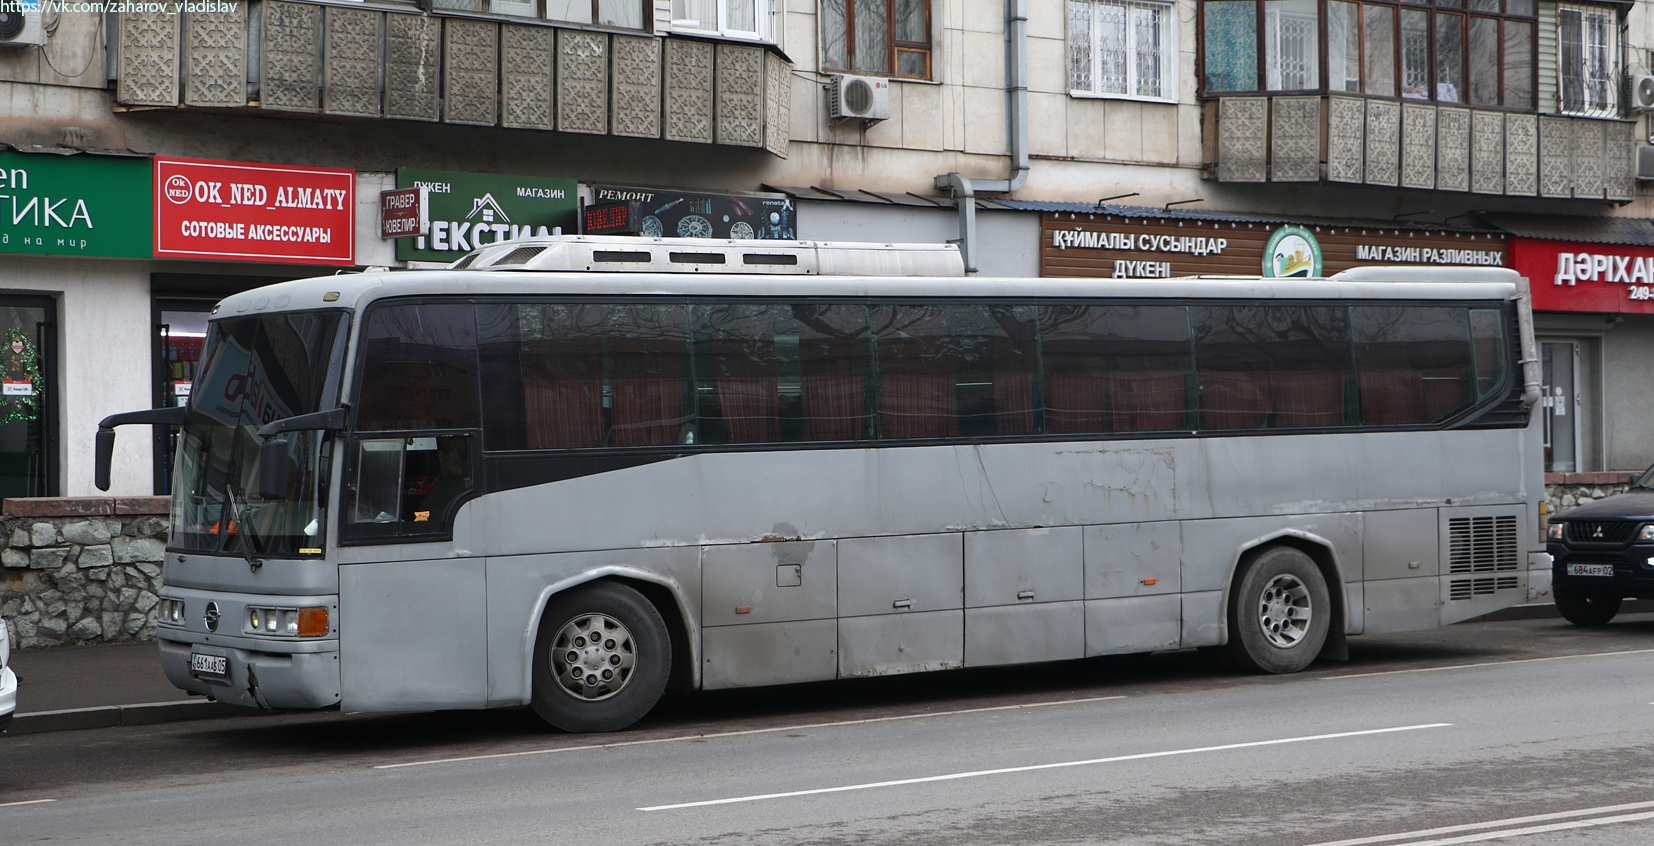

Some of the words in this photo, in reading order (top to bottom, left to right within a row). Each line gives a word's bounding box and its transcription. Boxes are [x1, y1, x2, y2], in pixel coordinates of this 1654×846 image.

[169, 188, 189, 198] NED
[194, 180, 347, 211] OK_NED_ALMATY
[386, 193, 415, 210] ГРАВЕР
[516, 187, 565, 200] МАГАЗИН
[598, 189, 654, 203] РЕМОНТ
[181, 220, 245, 240] СОТОВЫЕ
[247, 224, 331, 244] АКСЕССУАРЫ
[385, 217, 416, 233] ЮВЕЛИР
[24, 237, 43, 246] на
[1138, 234, 1227, 256] СУСЫНДАР
[1356, 245, 1420, 262] МАГАЗИН
[1422, 248, 1503, 266] РАЗЛИВНЫХ
[1112, 259, 1171, 279] ДҮКЕНІ
